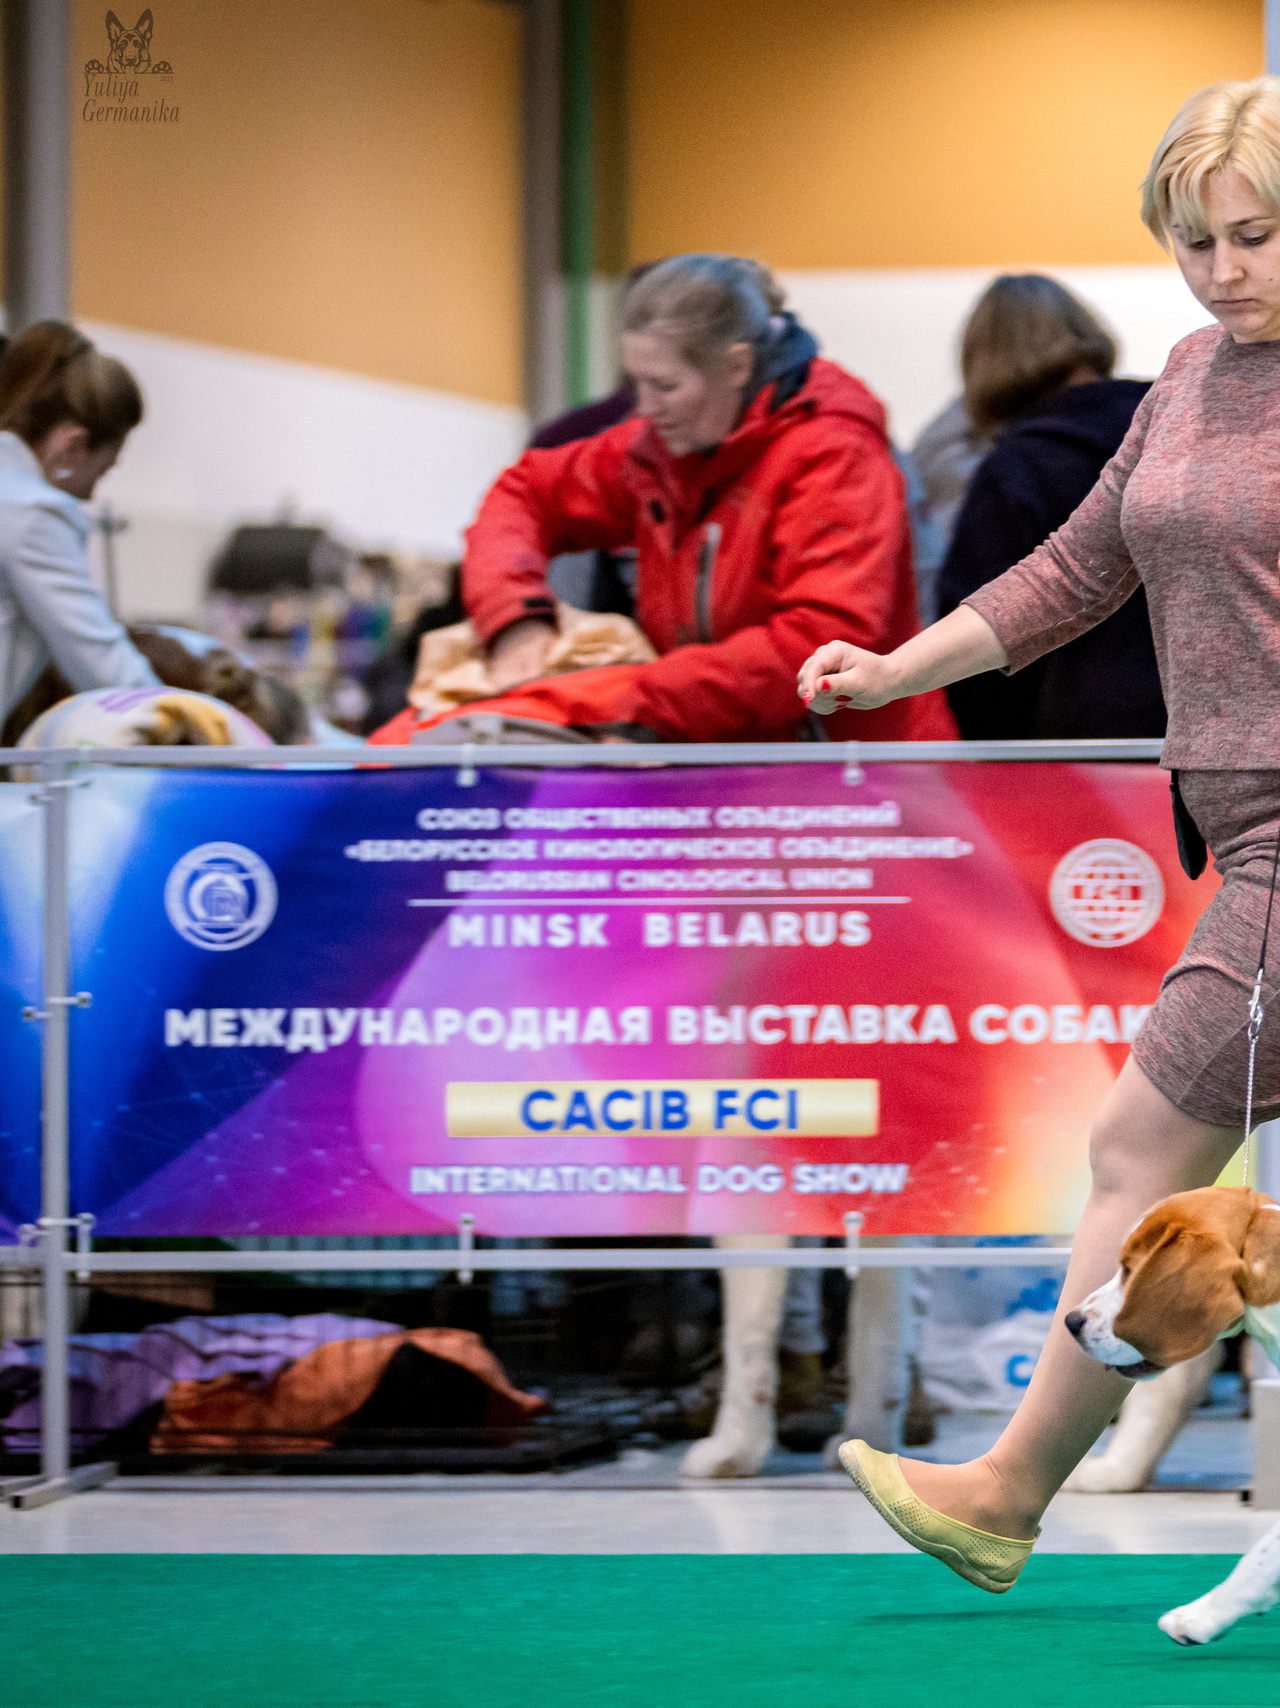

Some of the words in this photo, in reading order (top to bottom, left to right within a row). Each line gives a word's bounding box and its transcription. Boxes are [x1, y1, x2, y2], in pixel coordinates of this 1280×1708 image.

[417, 808, 501, 831] СОЮЗ
[790, 868, 873, 890] UNION
[449, 913, 609, 947] MINSK
[644, 910, 871, 947] BELARUS
[164, 1006, 652, 1053] МЕЖДУНАРОДНАЯ
[668, 1004, 958, 1045] ВЫСТАВКА
[521, 1089, 691, 1132] CACIB
[714, 1088, 799, 1131] FCI
[410, 1165, 687, 1194] INTERNATIONAL
[698, 1164, 785, 1193] DOG
[793, 1163, 908, 1193] SHOW
